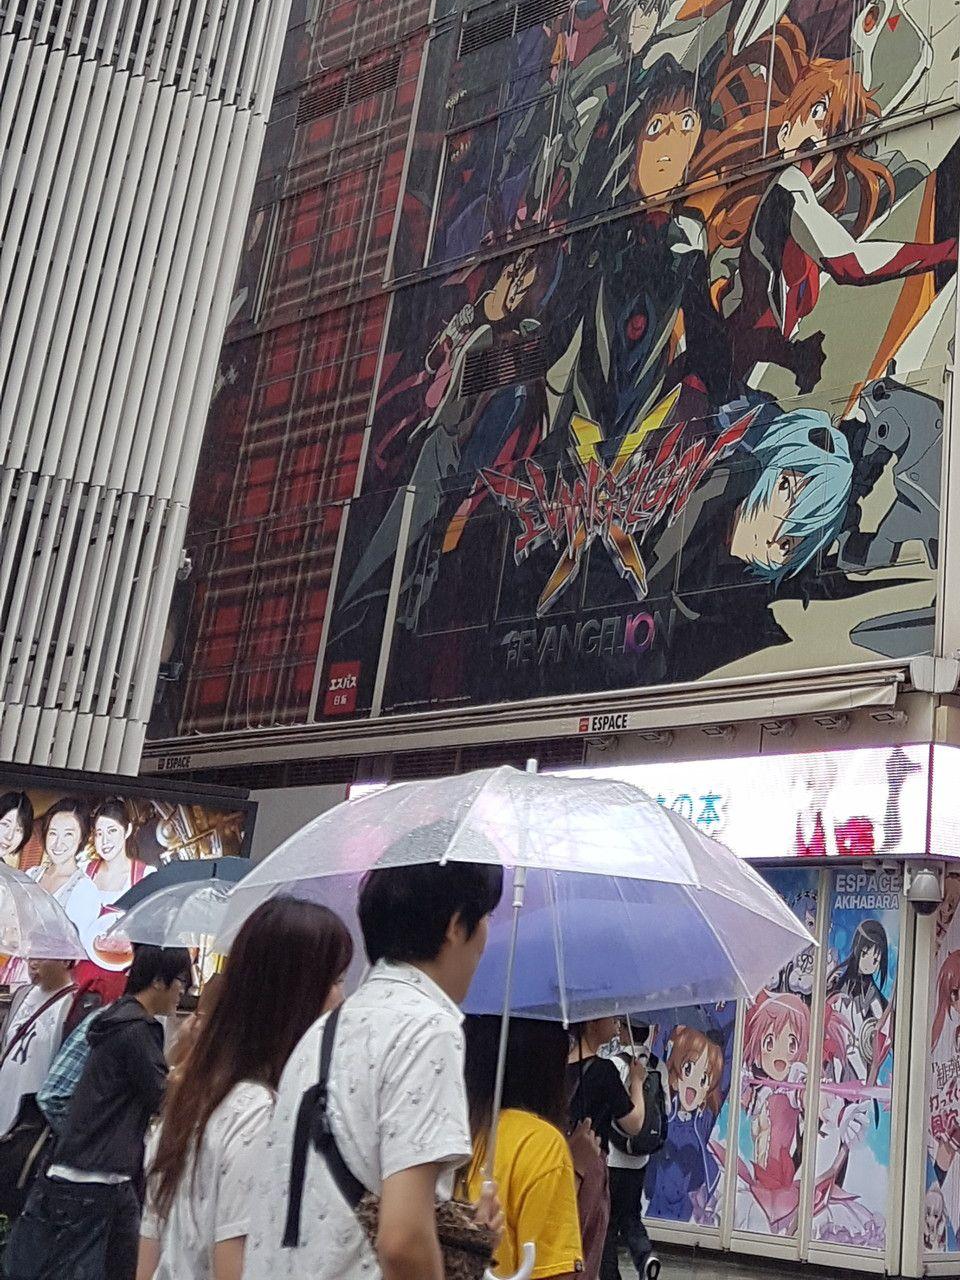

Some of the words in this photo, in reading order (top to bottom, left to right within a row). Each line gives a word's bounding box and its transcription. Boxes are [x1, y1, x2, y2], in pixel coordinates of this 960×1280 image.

[591, 713, 628, 732] ESPACE
[166, 755, 191, 770] ESPACE
[835, 873, 900, 893] ESPACE
[834, 894, 899, 910] AKIHABARA
